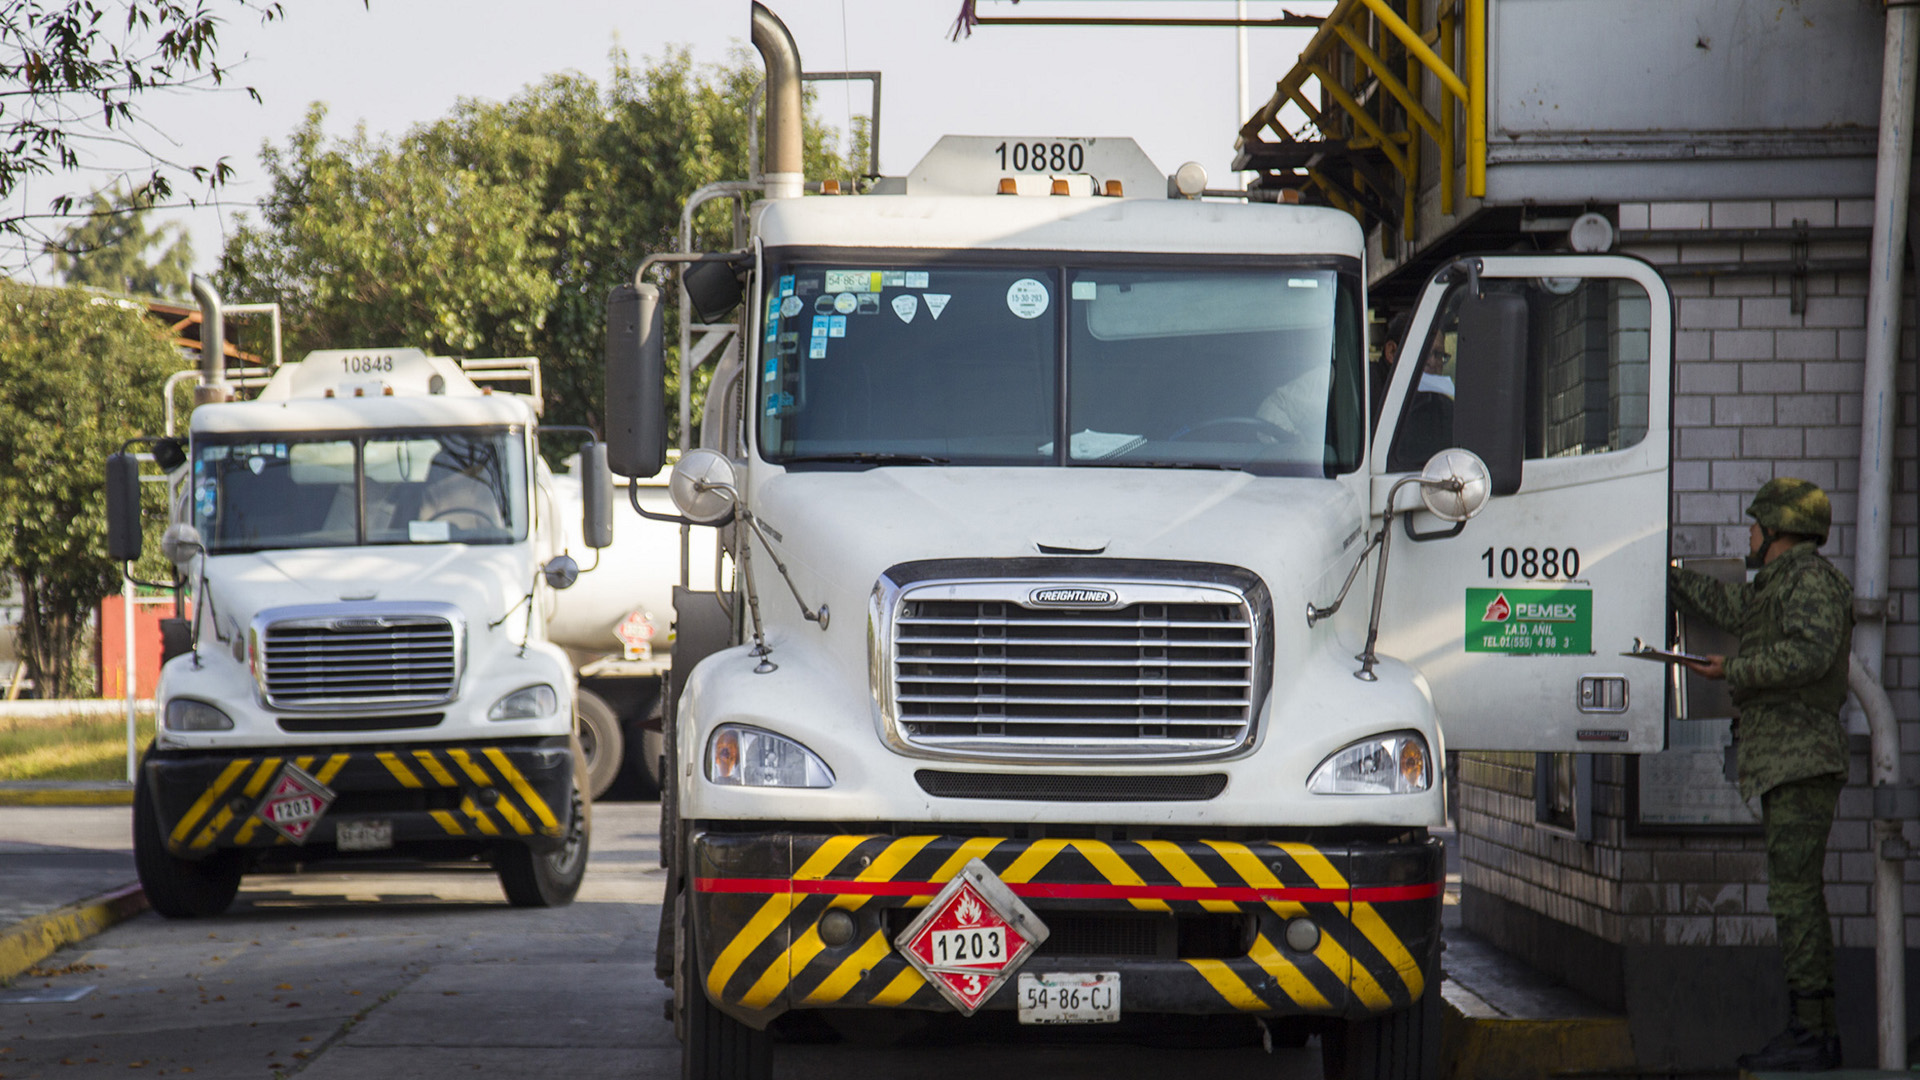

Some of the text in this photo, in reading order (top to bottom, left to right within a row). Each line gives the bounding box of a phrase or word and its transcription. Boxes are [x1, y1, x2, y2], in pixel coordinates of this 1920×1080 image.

[995, 142, 1084, 171] 10880
[342, 356, 392, 373] 10848
[1482, 547, 1580, 578] 10880
[1039, 590, 1108, 602] FREIGHTLINER
[1516, 603, 1576, 617] PEMEX
[276, 799, 310, 819] 1203
[938, 932, 1000, 961] 1203
[963, 974, 982, 996] 3
[1028, 988, 1111, 1010] 54-86-CJ
